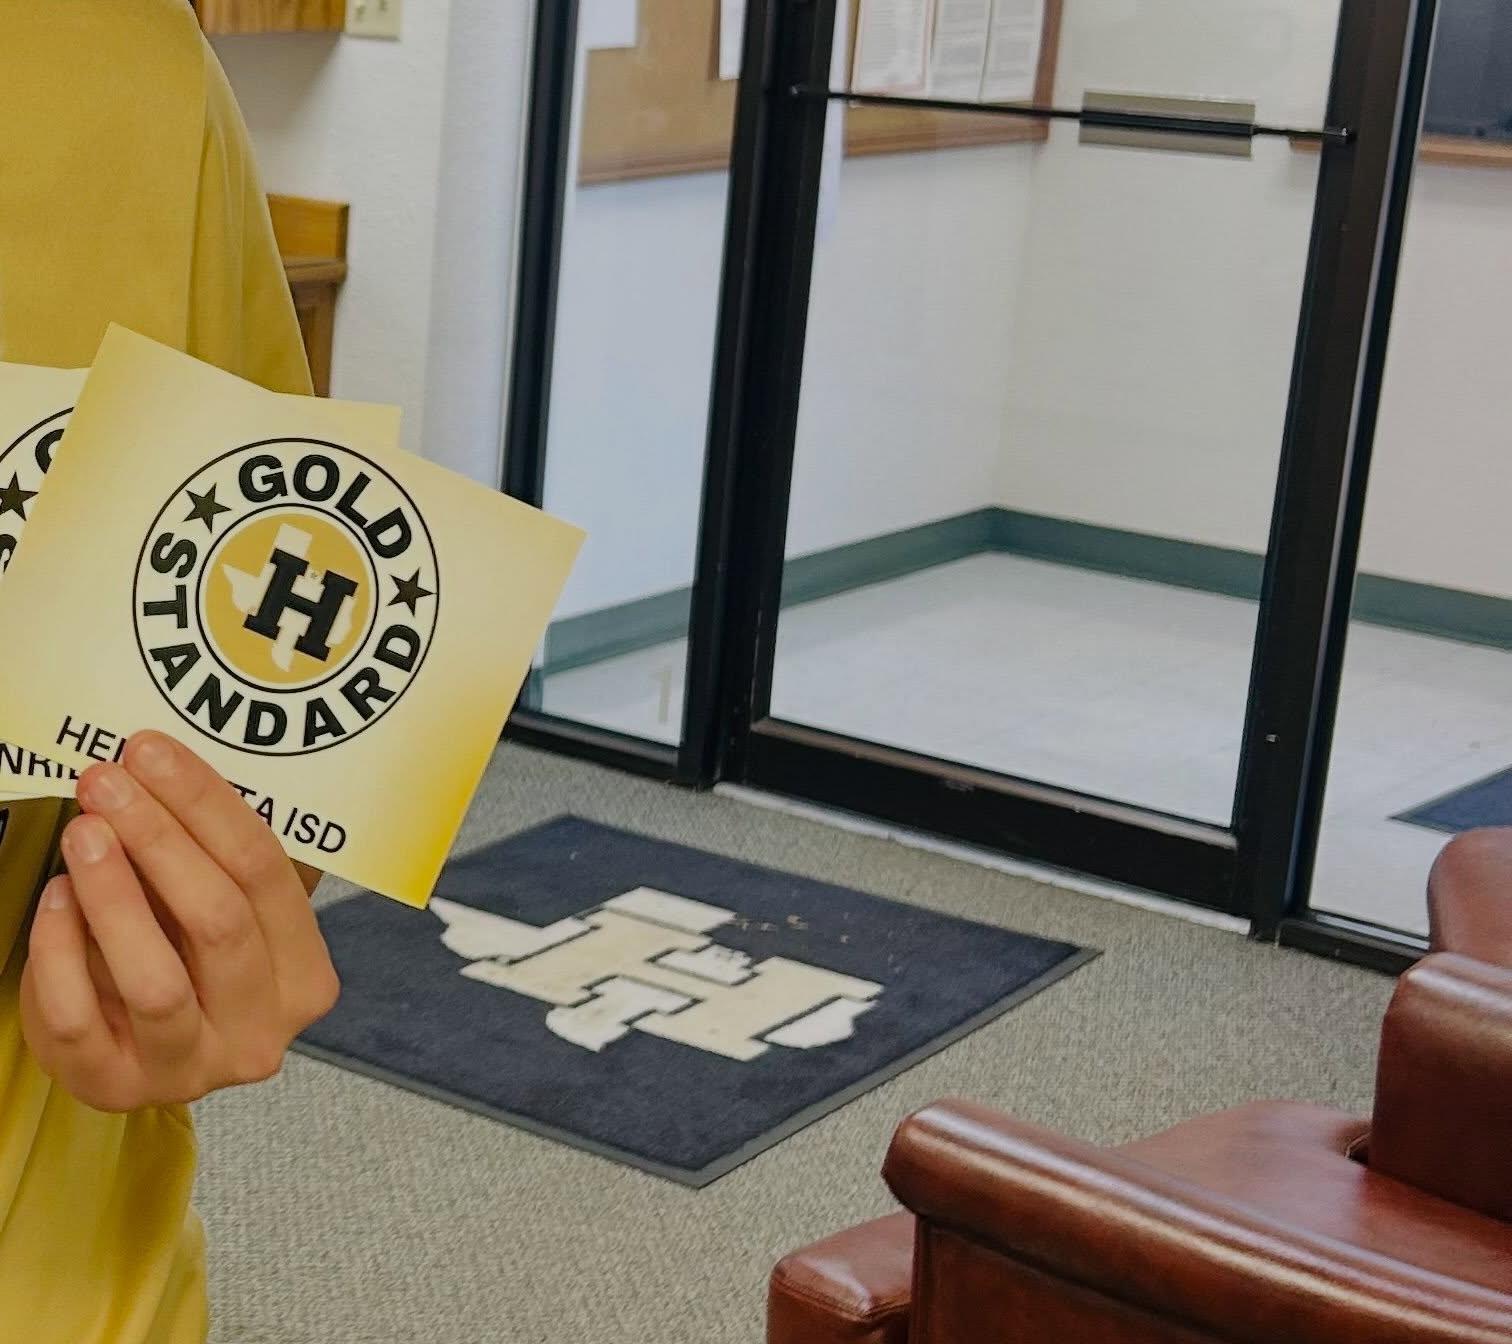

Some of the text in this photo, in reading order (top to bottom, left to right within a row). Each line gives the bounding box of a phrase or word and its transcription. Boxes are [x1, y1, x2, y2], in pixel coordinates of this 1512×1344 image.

[237, 453, 413, 560] GOLD
[142, 530, 421, 748] STANDARD
[241, 546, 359, 663] H
[283, 807, 347, 855] ISD
